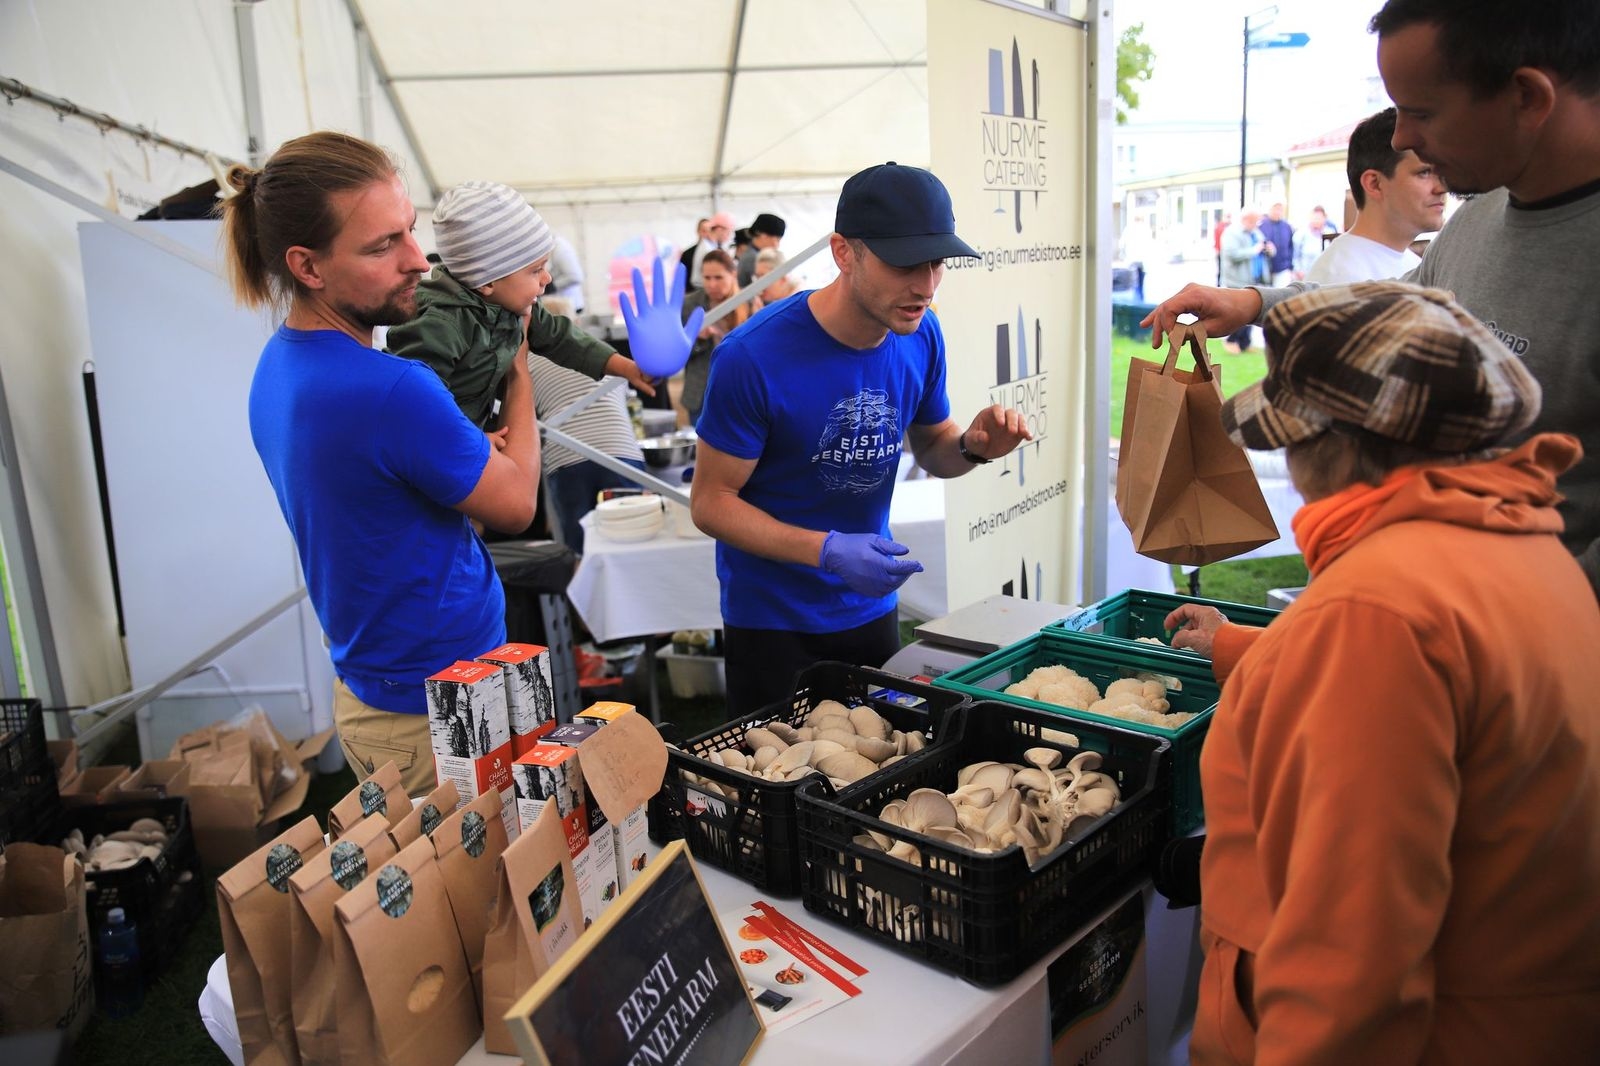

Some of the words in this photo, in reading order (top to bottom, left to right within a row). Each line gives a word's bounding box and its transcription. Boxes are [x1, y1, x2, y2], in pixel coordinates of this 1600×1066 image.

[982, 119, 1046, 159] NURME
[984, 159, 1047, 187] CATERING
[968, 479, 1068, 543] info@nurmebistroo.ee
[488, 767, 507, 783] CHAGA
[568, 827, 585, 845] CHAGA
[616, 952, 680, 1042] EESTI
